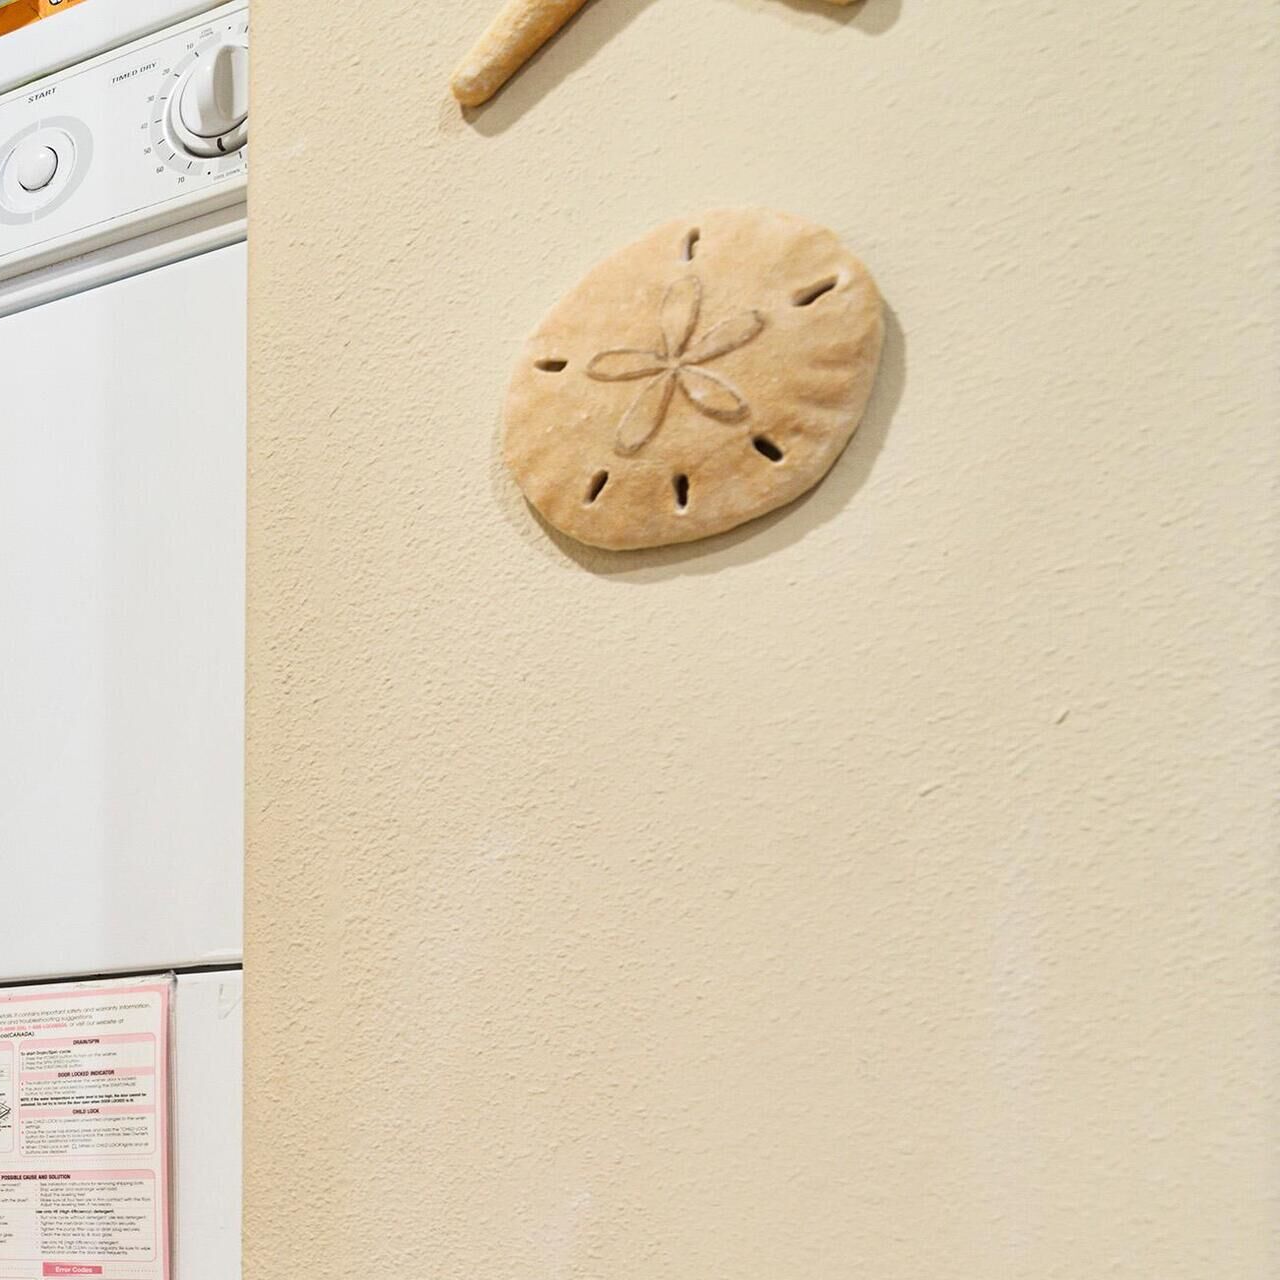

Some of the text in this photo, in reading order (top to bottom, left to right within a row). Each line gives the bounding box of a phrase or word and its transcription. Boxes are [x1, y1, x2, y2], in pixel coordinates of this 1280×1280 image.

[112, 62, 157, 84] TIMED DRY
[28, 87, 57, 103] START
[155, 165, 164, 174] 60
[177, 176, 185, 184] 70
[72, 1266, 93, 1274] Codes
